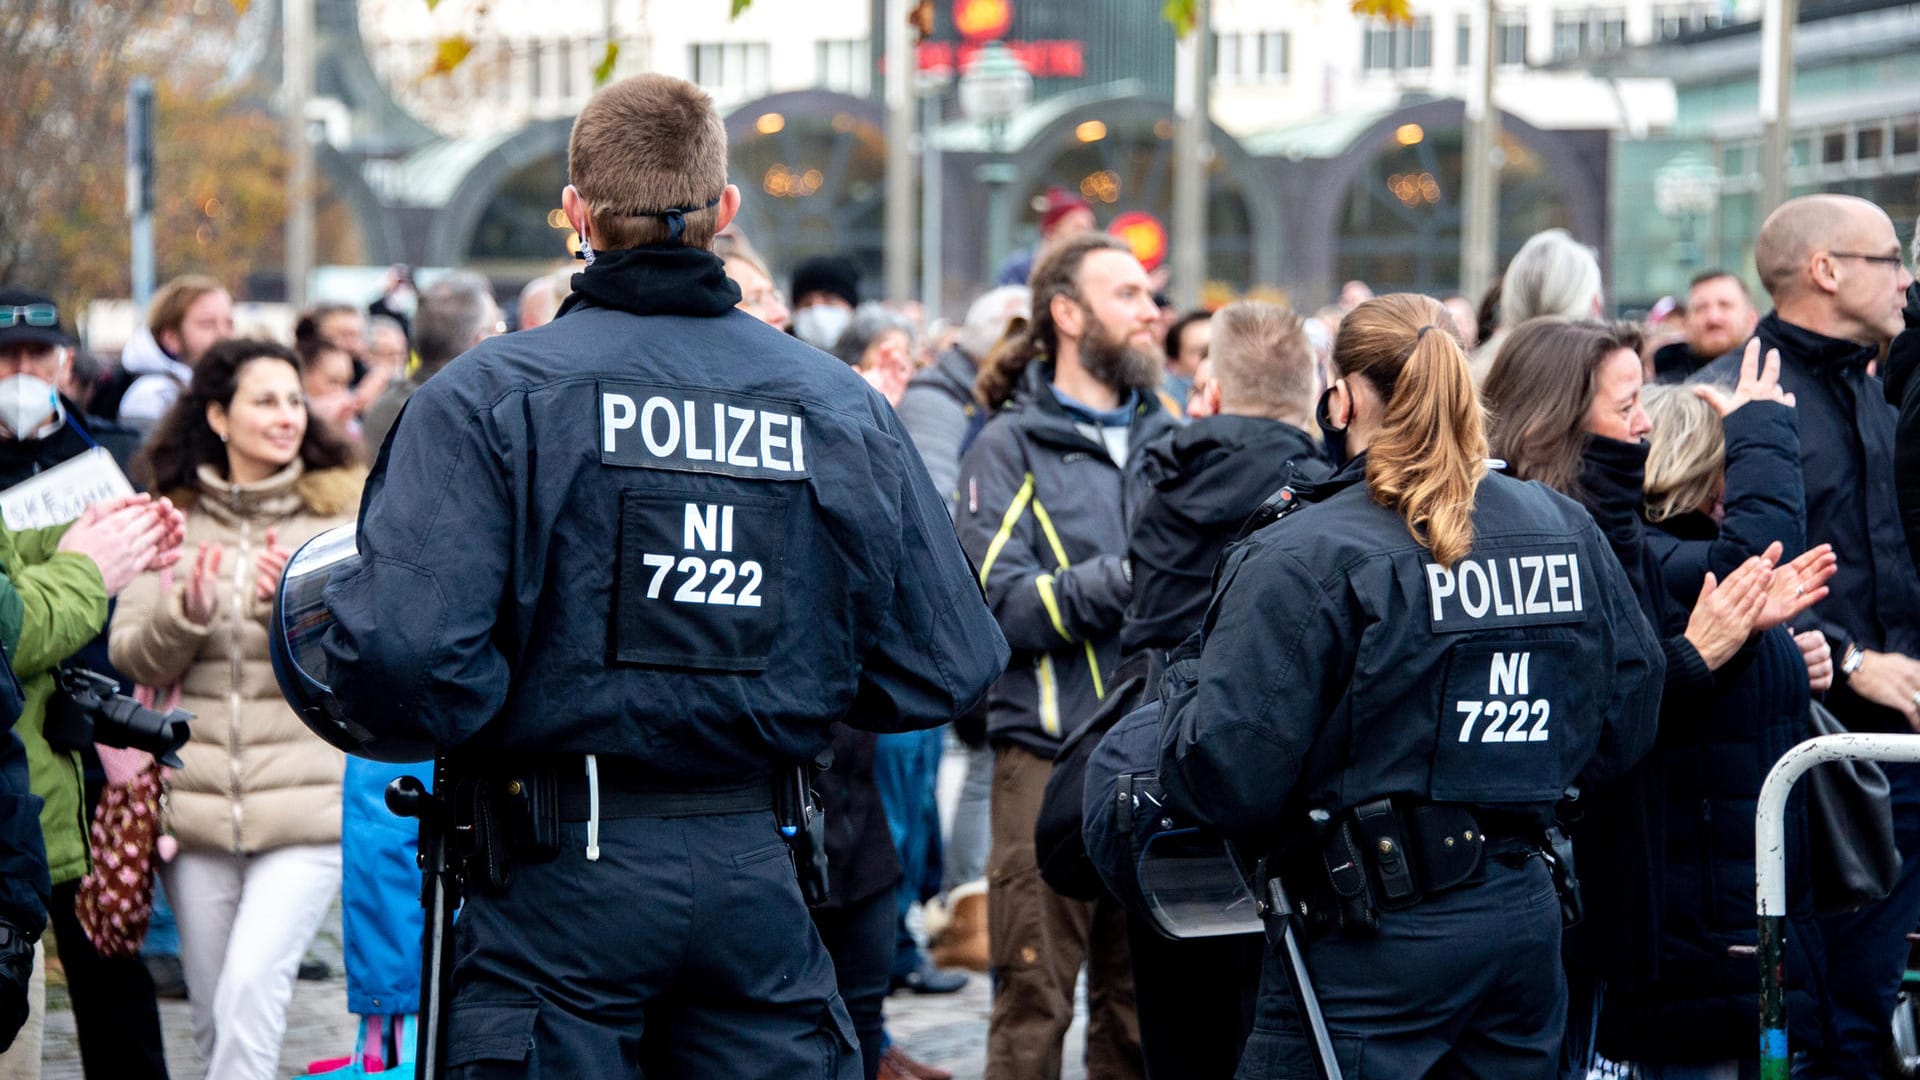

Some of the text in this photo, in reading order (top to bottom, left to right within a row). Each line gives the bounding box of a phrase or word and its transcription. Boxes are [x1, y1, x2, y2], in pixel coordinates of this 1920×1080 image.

[602, 393, 805, 471] POLIZEI
[684, 503, 734, 552] NI
[643, 554, 763, 607] 7222
[1426, 554, 1583, 621] POLIZEI
[1489, 652, 1530, 695] NI
[1456, 699, 1550, 742] 7222
